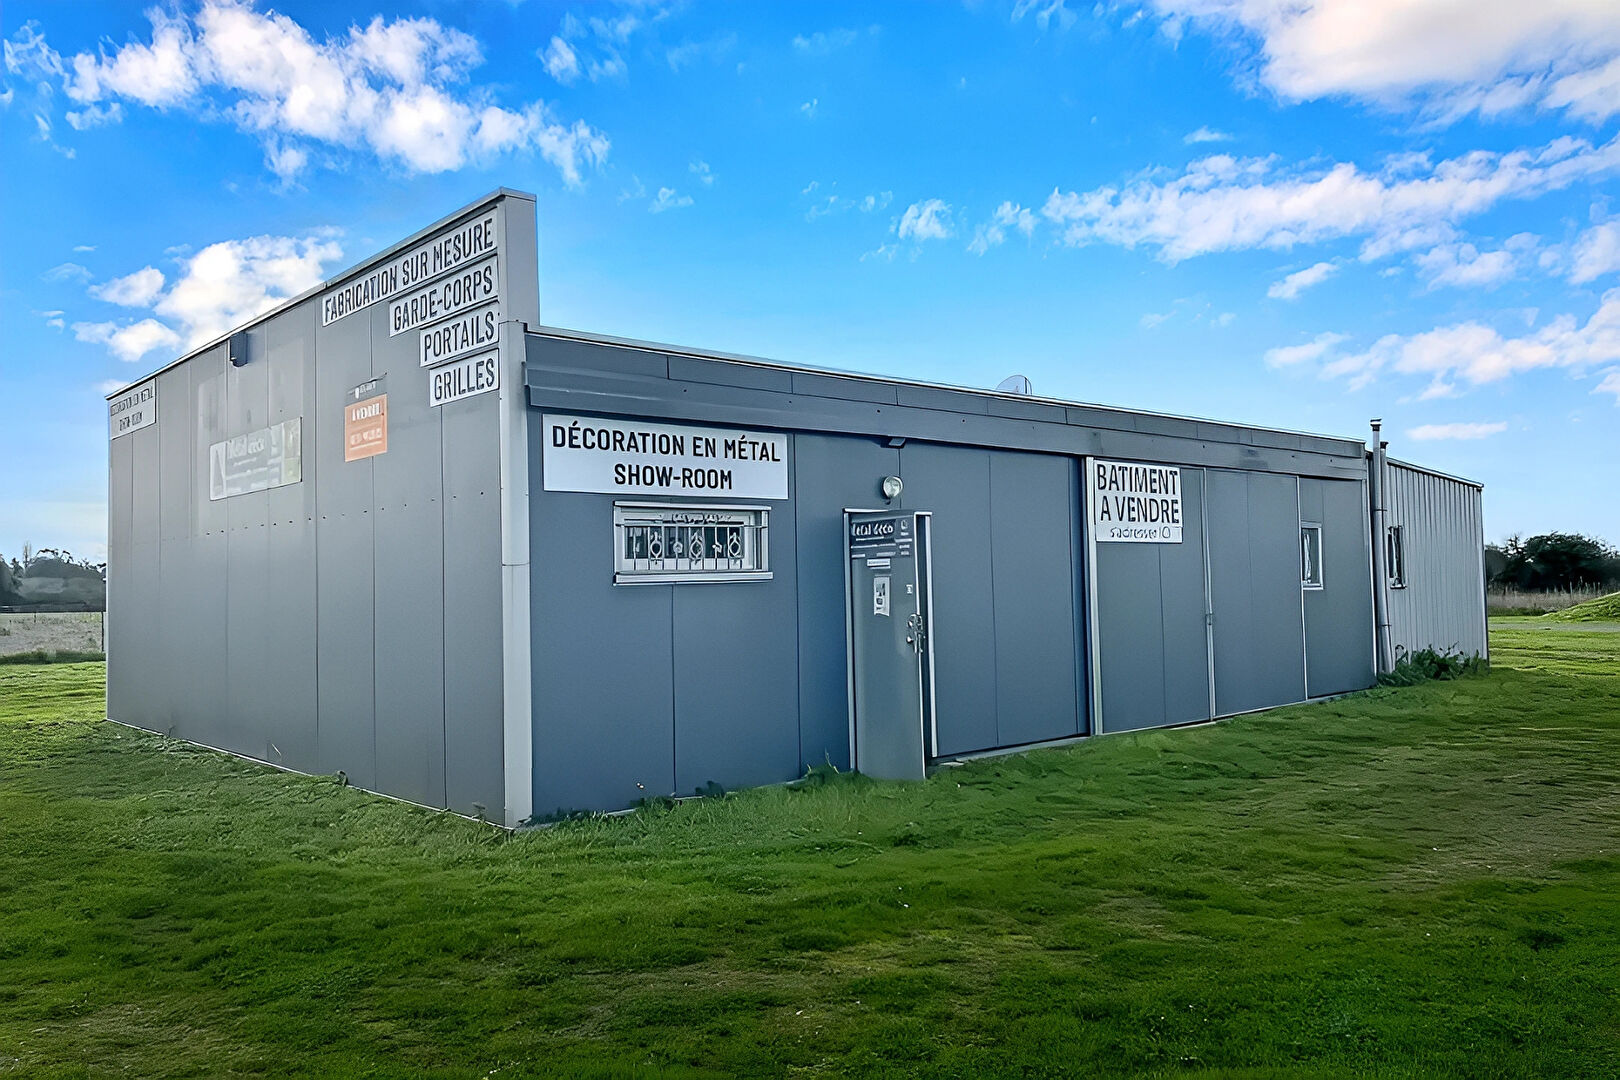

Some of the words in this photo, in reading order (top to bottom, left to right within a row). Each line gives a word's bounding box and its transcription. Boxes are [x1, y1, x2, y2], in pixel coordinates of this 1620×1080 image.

[325, 265, 397, 323] FABRICATION
[402, 250, 428, 286] SUR
[433, 217, 493, 273] MESURE
[393, 265, 492, 331] GARDE-CORPS
[424, 311, 494, 362] PORTAILS
[434, 357, 495, 401] GRILLES
[552, 420, 684, 456] DÉCORATION
[693, 436, 716, 458] EN
[724, 434, 781, 462] MÉTAL
[614, 463, 732, 490] SHOW-ROOM
[1097, 463, 1178, 495] BATIMENT
[1100, 495, 1111, 521] A
[1115, 495, 1179, 524] VENDRE
